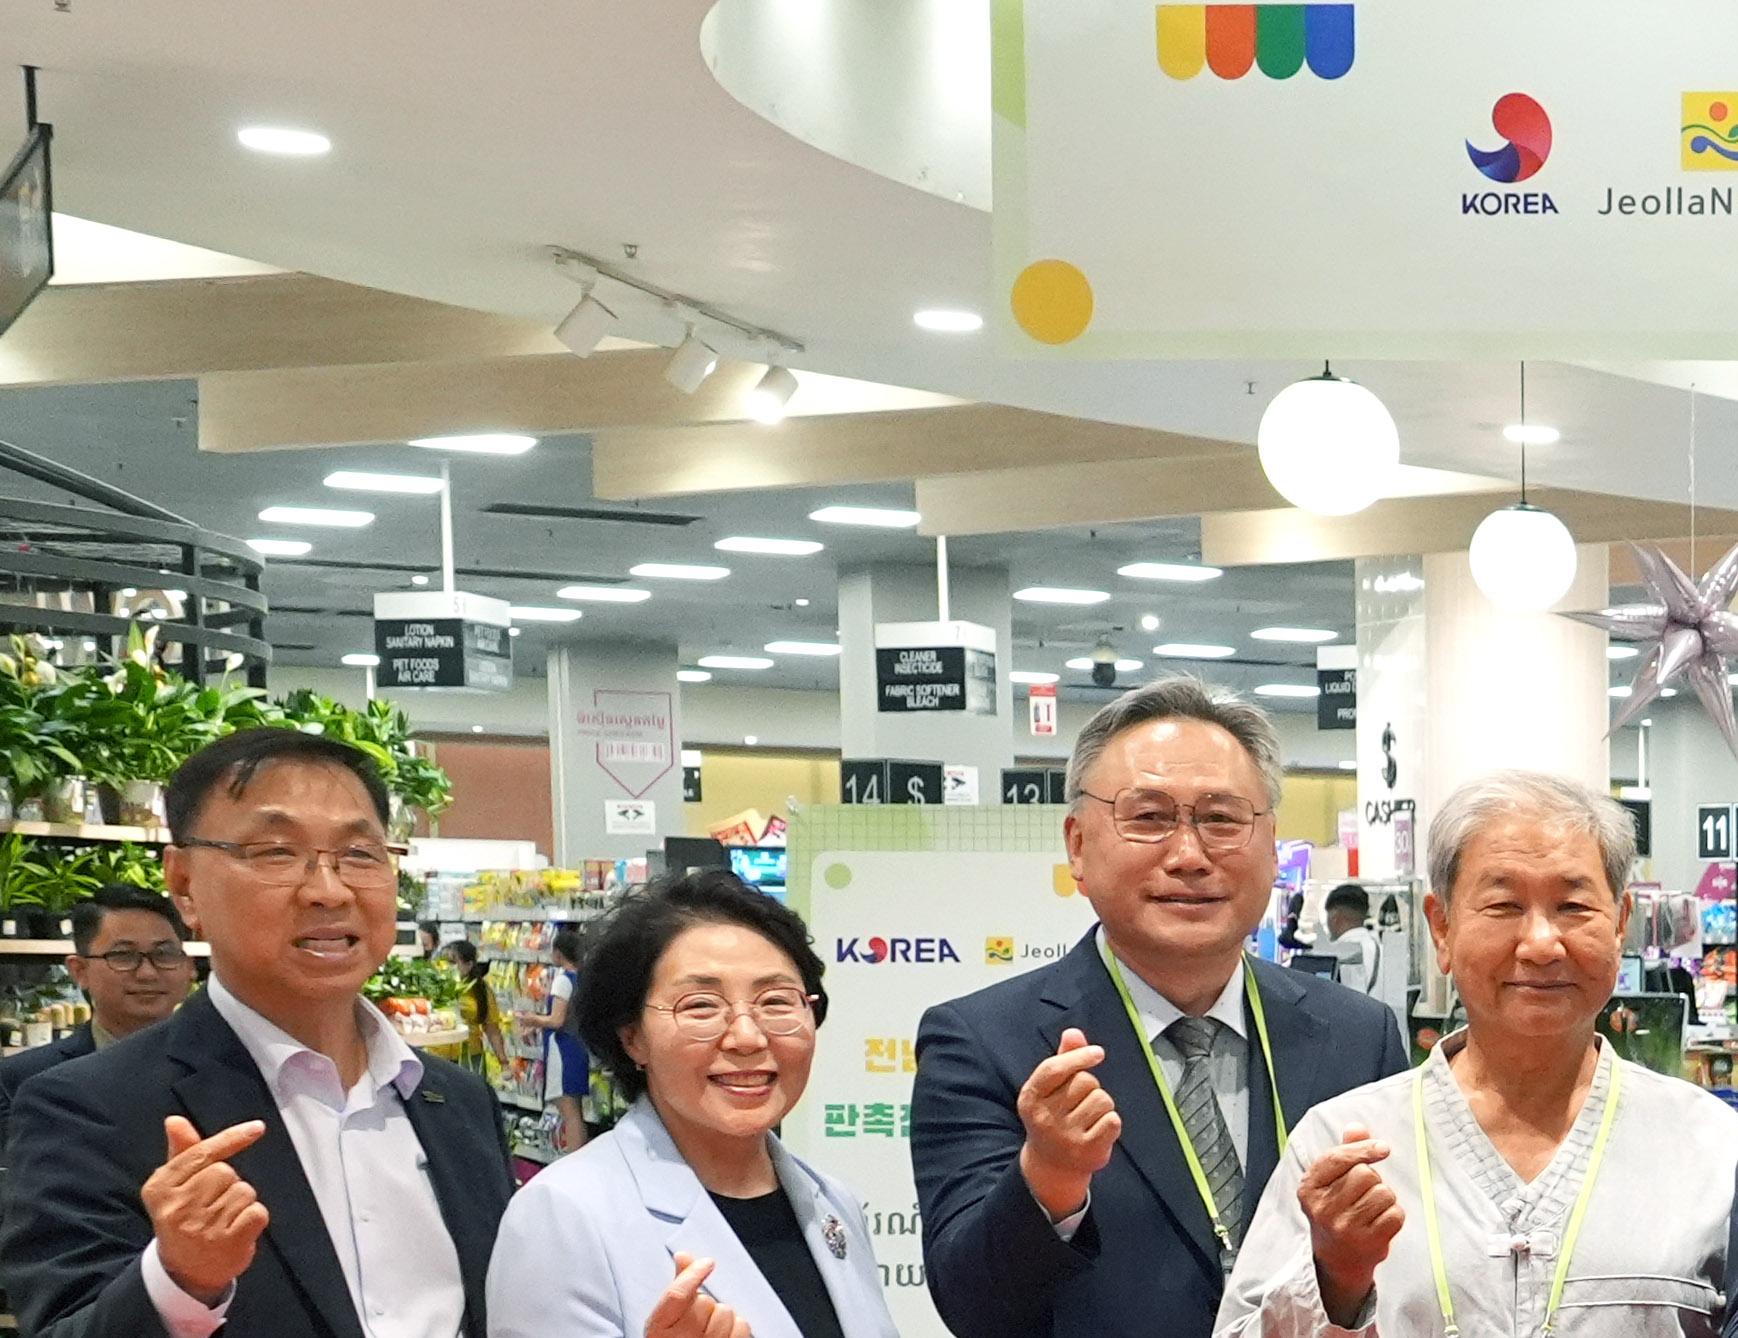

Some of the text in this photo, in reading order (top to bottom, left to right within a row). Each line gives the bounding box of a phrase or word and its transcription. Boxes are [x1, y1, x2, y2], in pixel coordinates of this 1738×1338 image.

[1461, 193, 1559, 215] KOREA
[404, 623, 434, 637] LOTION
[386, 634, 454, 649] SANITARY NAPKIN
[393, 657, 440, 671] PET FOODS
[900, 651, 937, 663] CLEANER
[894, 662, 943, 674] INSECTICIDE
[413, 670, 436, 683] CARE
[885, 683, 960, 698] FABRIC SOFTENER
[906, 696, 939, 708] BLEACH
[1702, 814, 1727, 850] 11
[836, 937, 961, 964] KOREA
